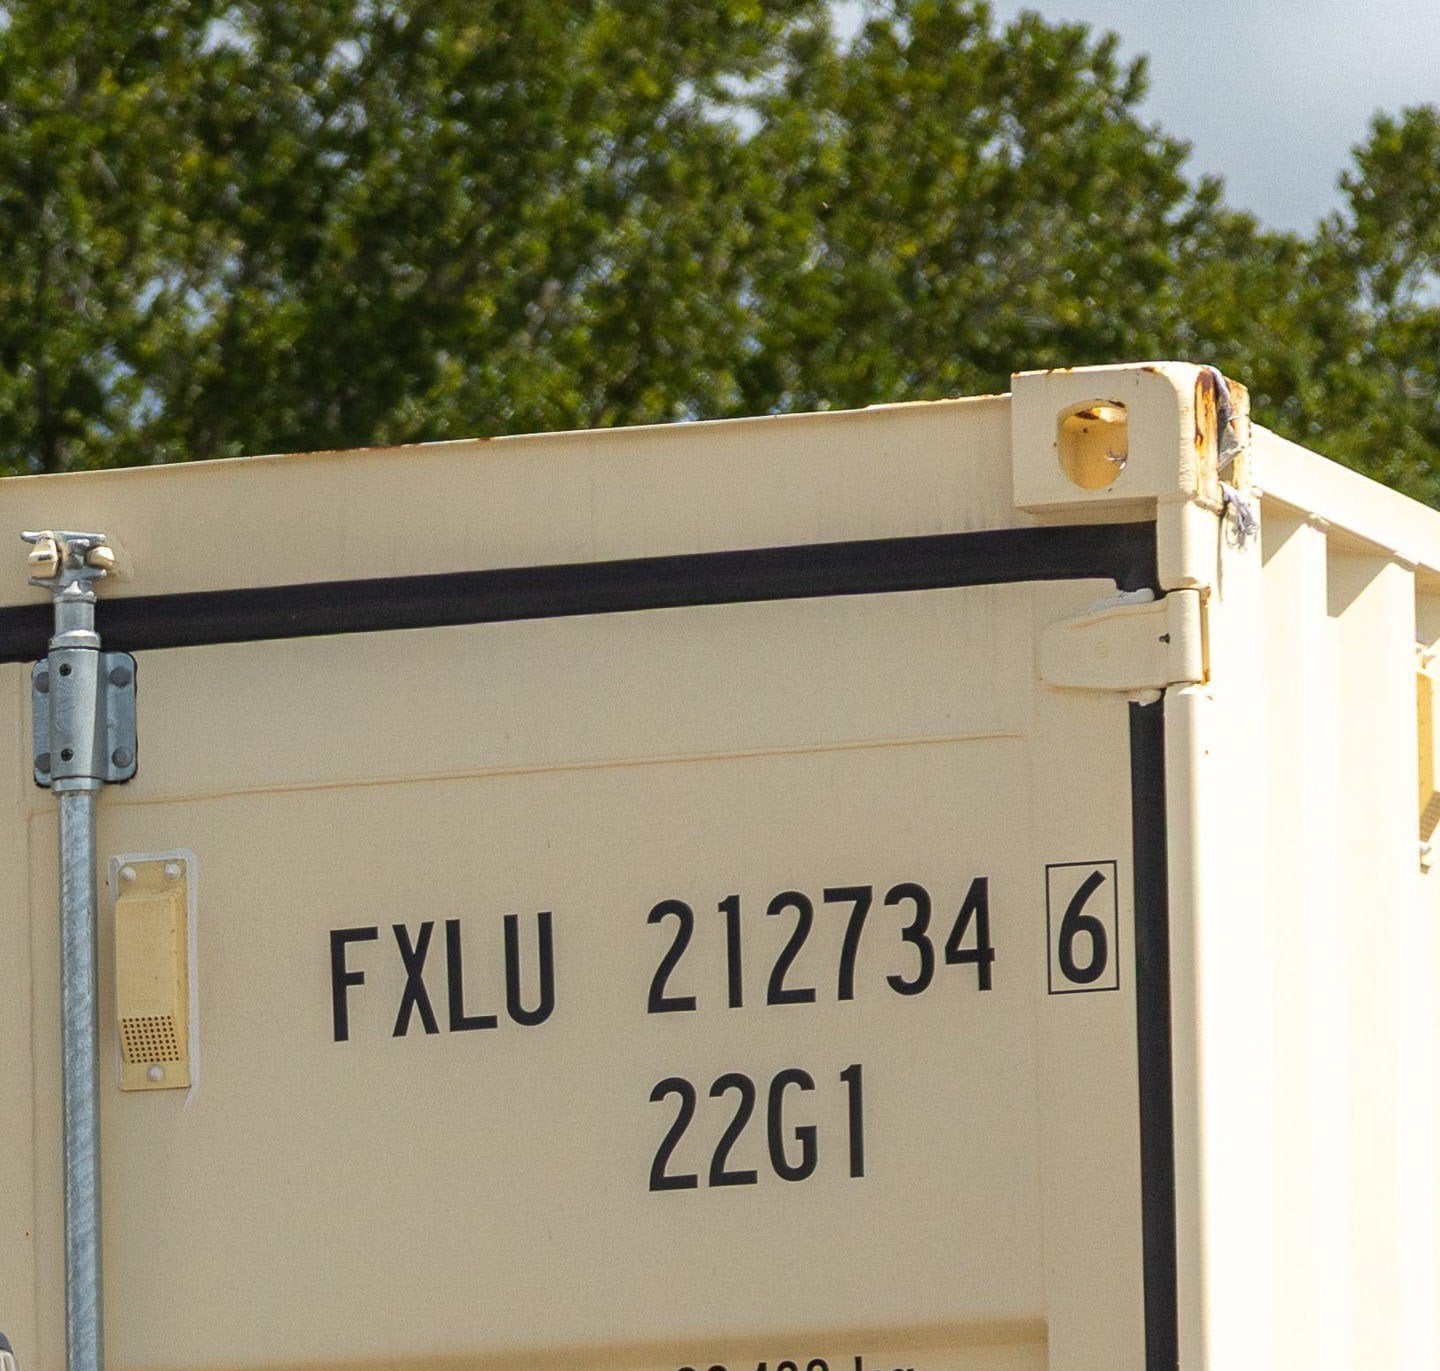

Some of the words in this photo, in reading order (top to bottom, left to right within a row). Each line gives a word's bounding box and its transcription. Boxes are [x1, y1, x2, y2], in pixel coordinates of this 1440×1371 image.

[330, 911, 555, 1042] FXLU
[646, 876, 996, 1014] 212734
[1058, 870, 1109, 985] 6
[649, 1063, 865, 1192] 22G1
